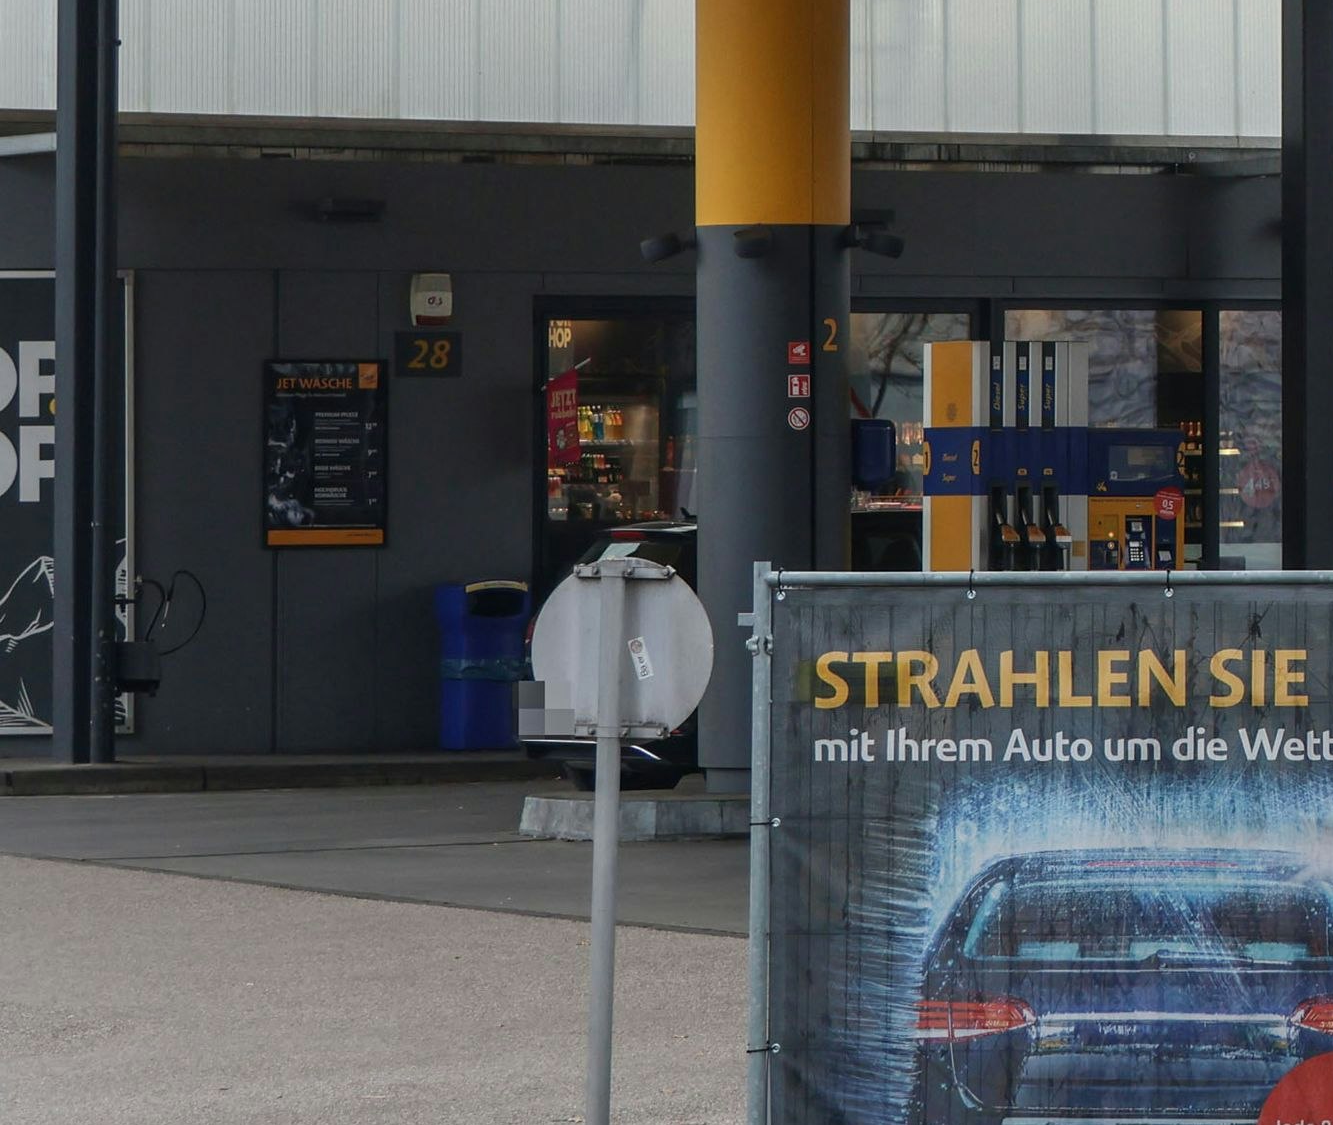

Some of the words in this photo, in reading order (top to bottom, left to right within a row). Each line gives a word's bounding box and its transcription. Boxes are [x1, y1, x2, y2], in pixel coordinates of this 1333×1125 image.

[823, 318, 838, 352] 2
[408, 339, 451, 369] 28
[276, 378, 297, 389] JET
[814, 648, 1187, 709] STRAHLEN
[1209, 648, 1309, 708] SIE
[814, 728, 875, 762] mit
[886, 727, 993, 762] Ihrem
[1002, 728, 1093, 762] Auto
[1104, 738, 1161, 762] um
[1172, 726, 1229, 762] die
